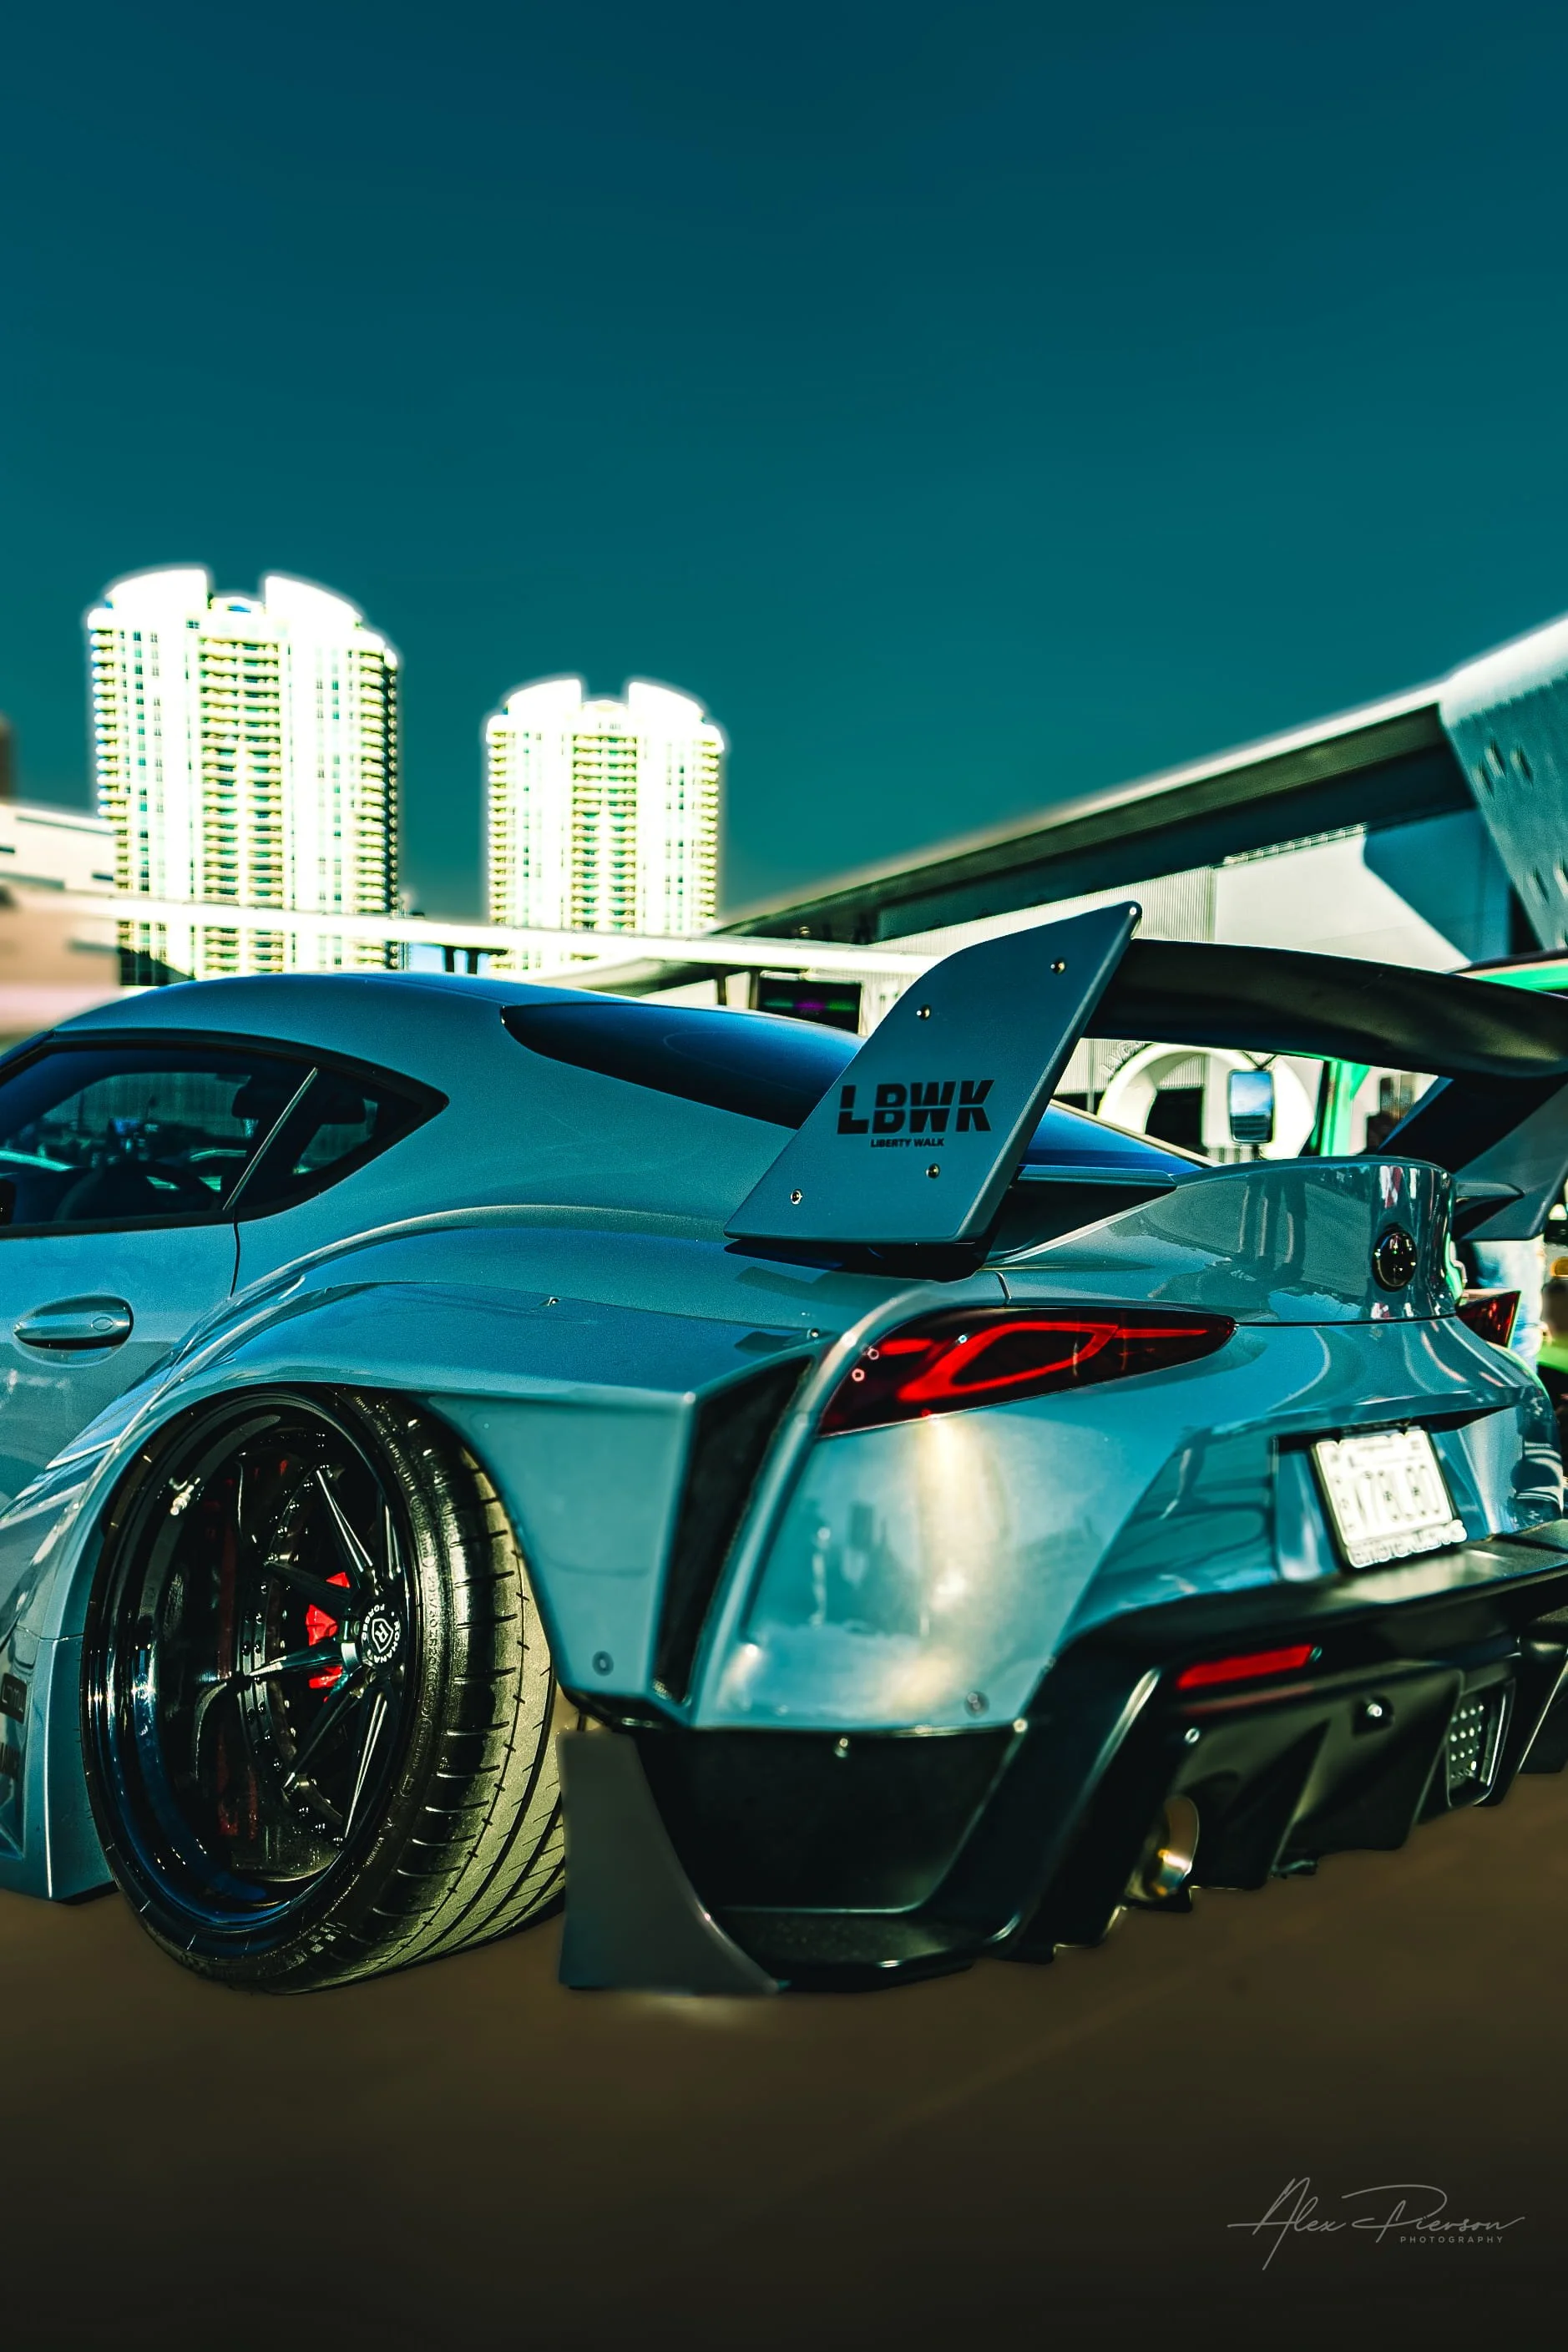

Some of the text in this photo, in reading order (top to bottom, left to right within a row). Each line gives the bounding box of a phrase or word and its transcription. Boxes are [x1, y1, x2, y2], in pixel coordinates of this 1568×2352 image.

[837, 1080, 994, 1135] LBWK
[870, 1137, 944, 1148] LIBERTY WALK
[373, 1621, 400, 1663] ROHANA
